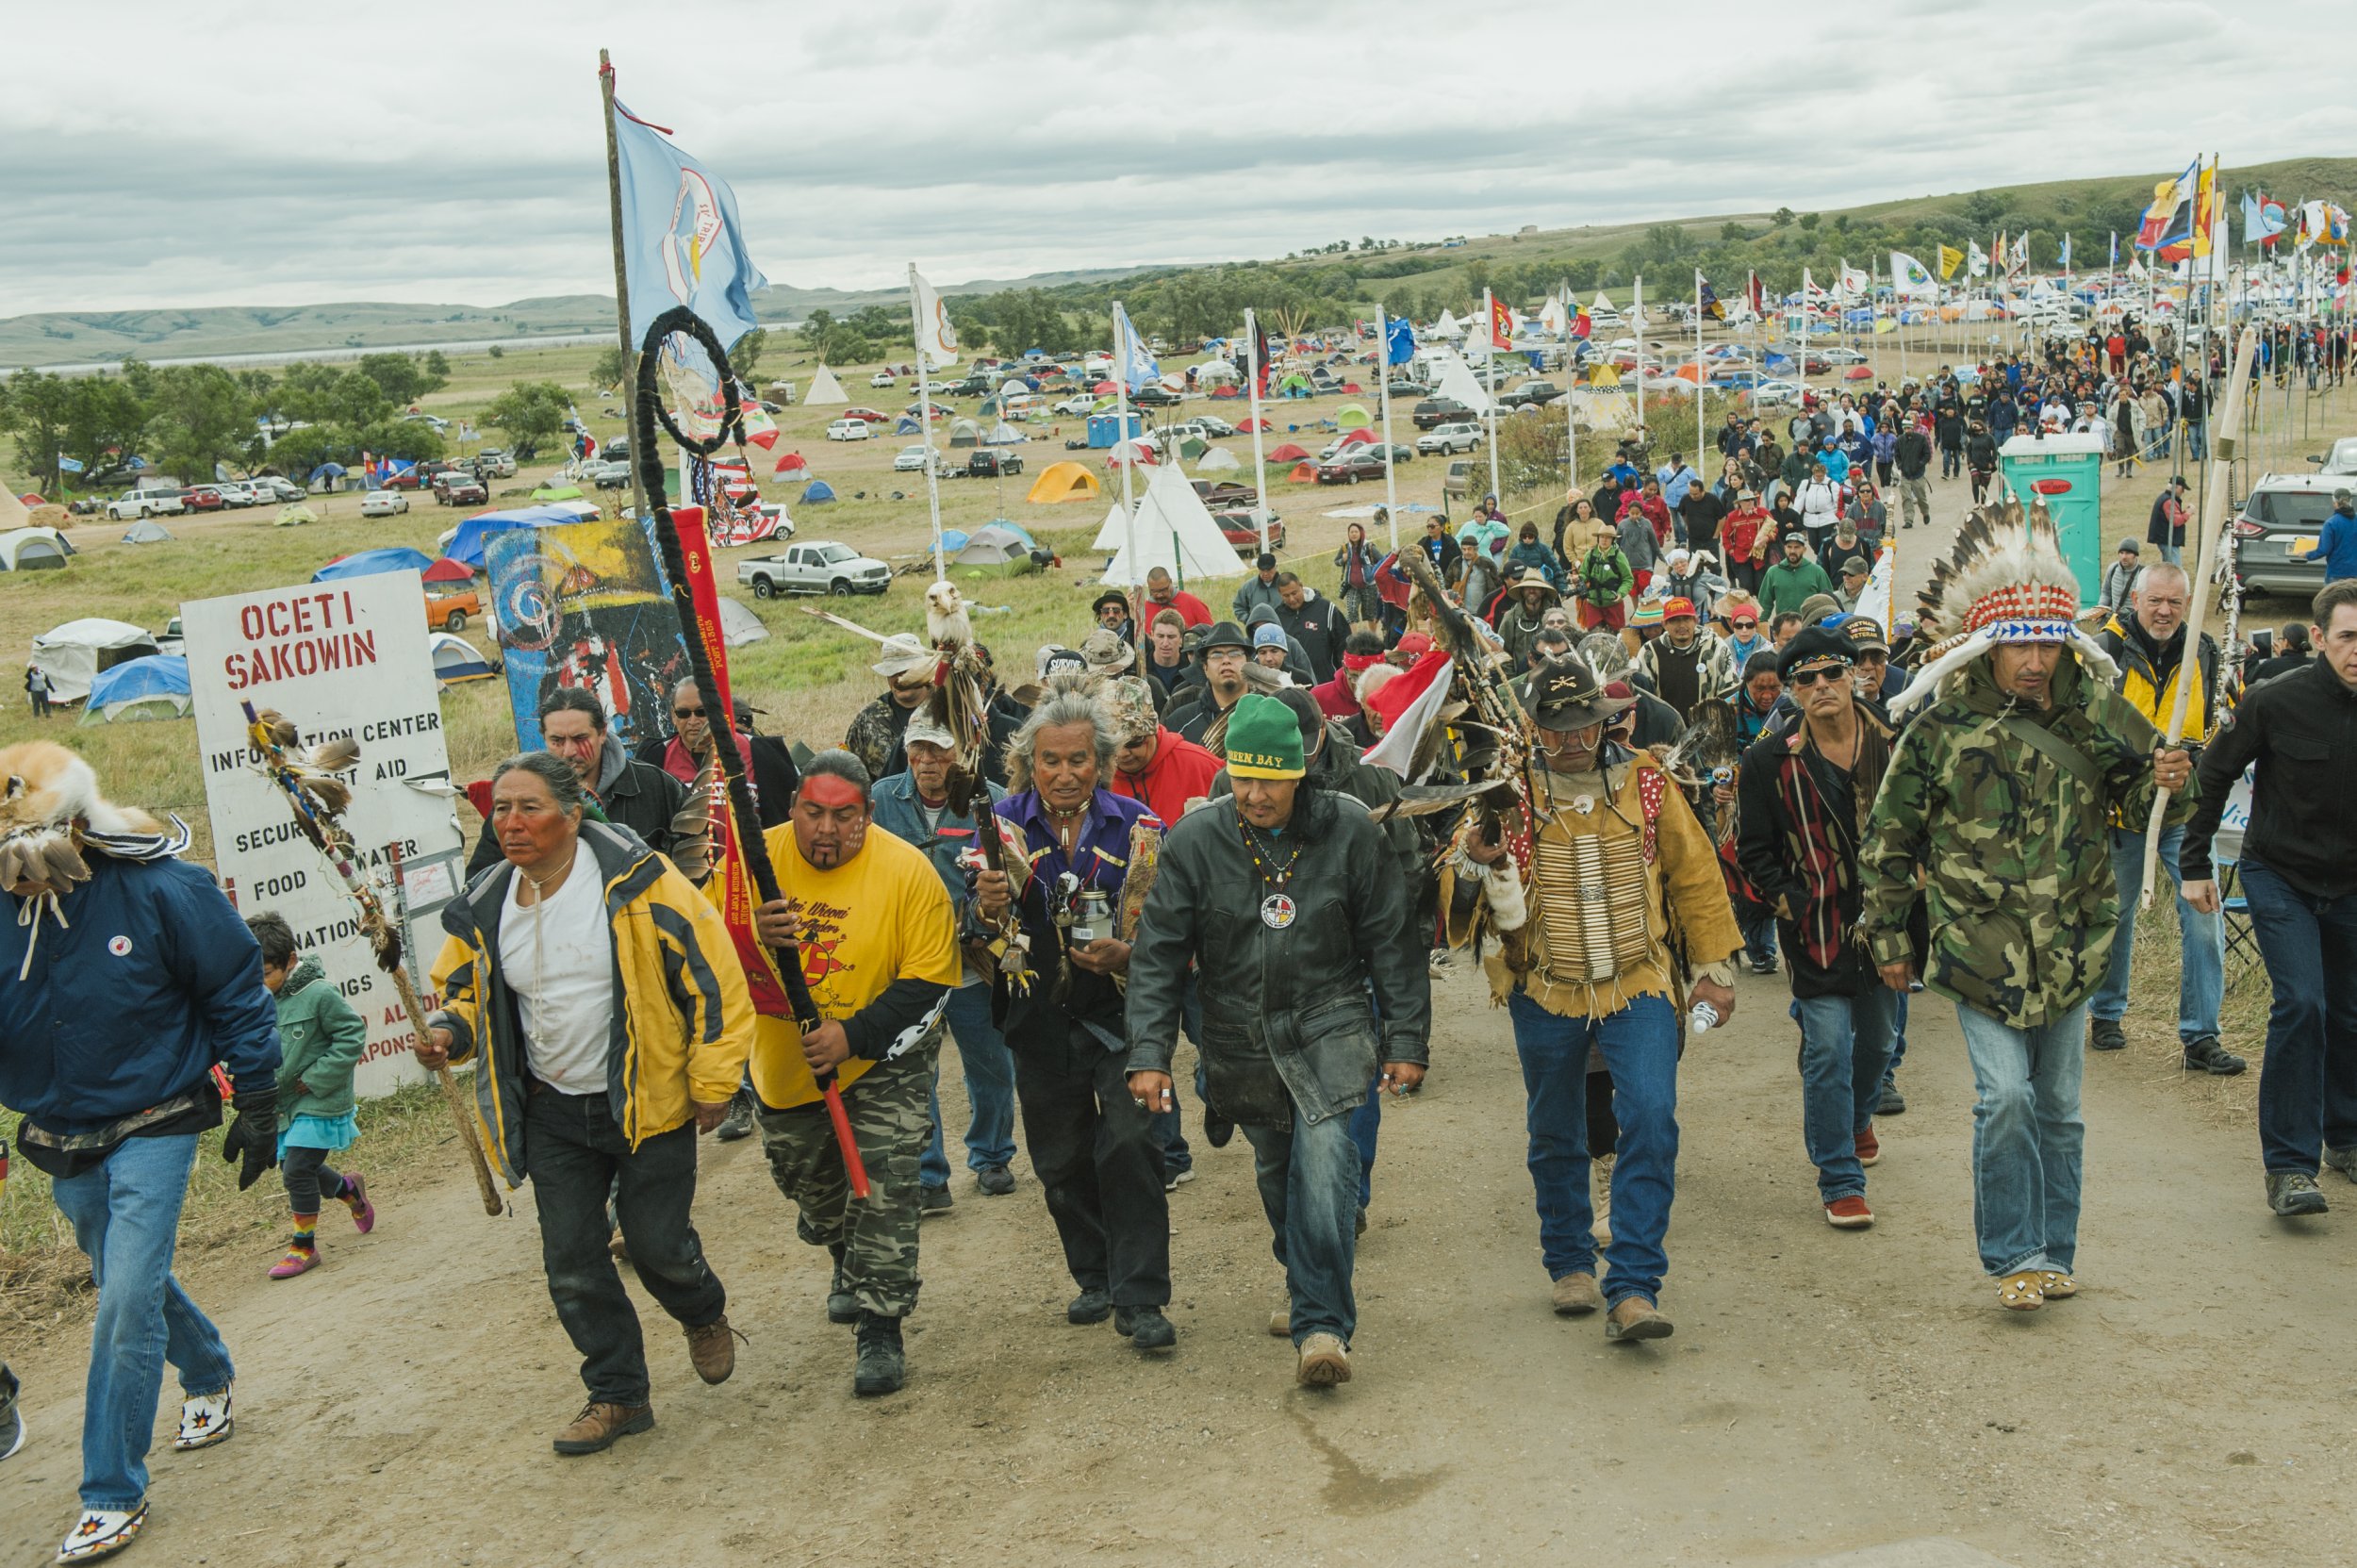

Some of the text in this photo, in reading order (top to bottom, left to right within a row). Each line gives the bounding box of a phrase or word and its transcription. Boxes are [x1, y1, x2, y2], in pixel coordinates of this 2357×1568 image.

[240, 590, 355, 641] OCETI
[1847, 620, 1876, 630] VIETNAM
[224, 629, 377, 690] SAKOWIN
[1050, 658, 1082, 671] SURVIVE
[211, 712, 440, 773] INFOTION CENTER
[375, 758, 407, 782] AID
[1256, 754, 1283, 767] BAY
[236, 820, 305, 853] SECUR
[254, 869, 307, 901] FOOD
[294, 916, 362, 952] NATION
[357, 1032, 415, 1066] APONS
